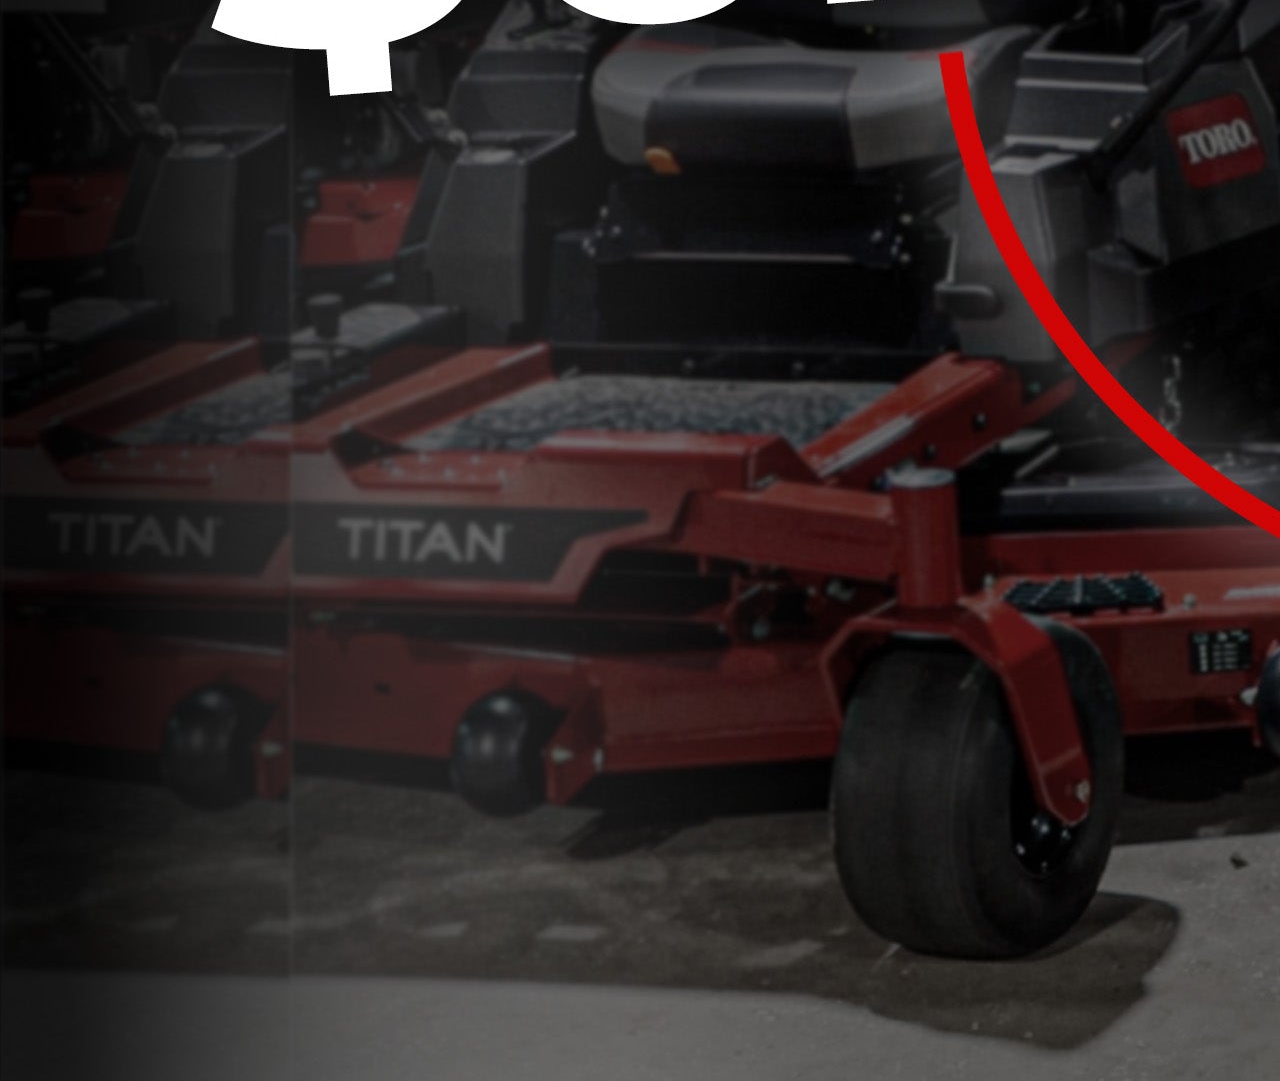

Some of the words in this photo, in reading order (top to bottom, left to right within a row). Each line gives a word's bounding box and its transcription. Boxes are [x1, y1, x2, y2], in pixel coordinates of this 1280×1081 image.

[1177, 118, 1258, 166] TORO
[47, 511, 218, 559] TITAN
[337, 518, 508, 564] TITAN
